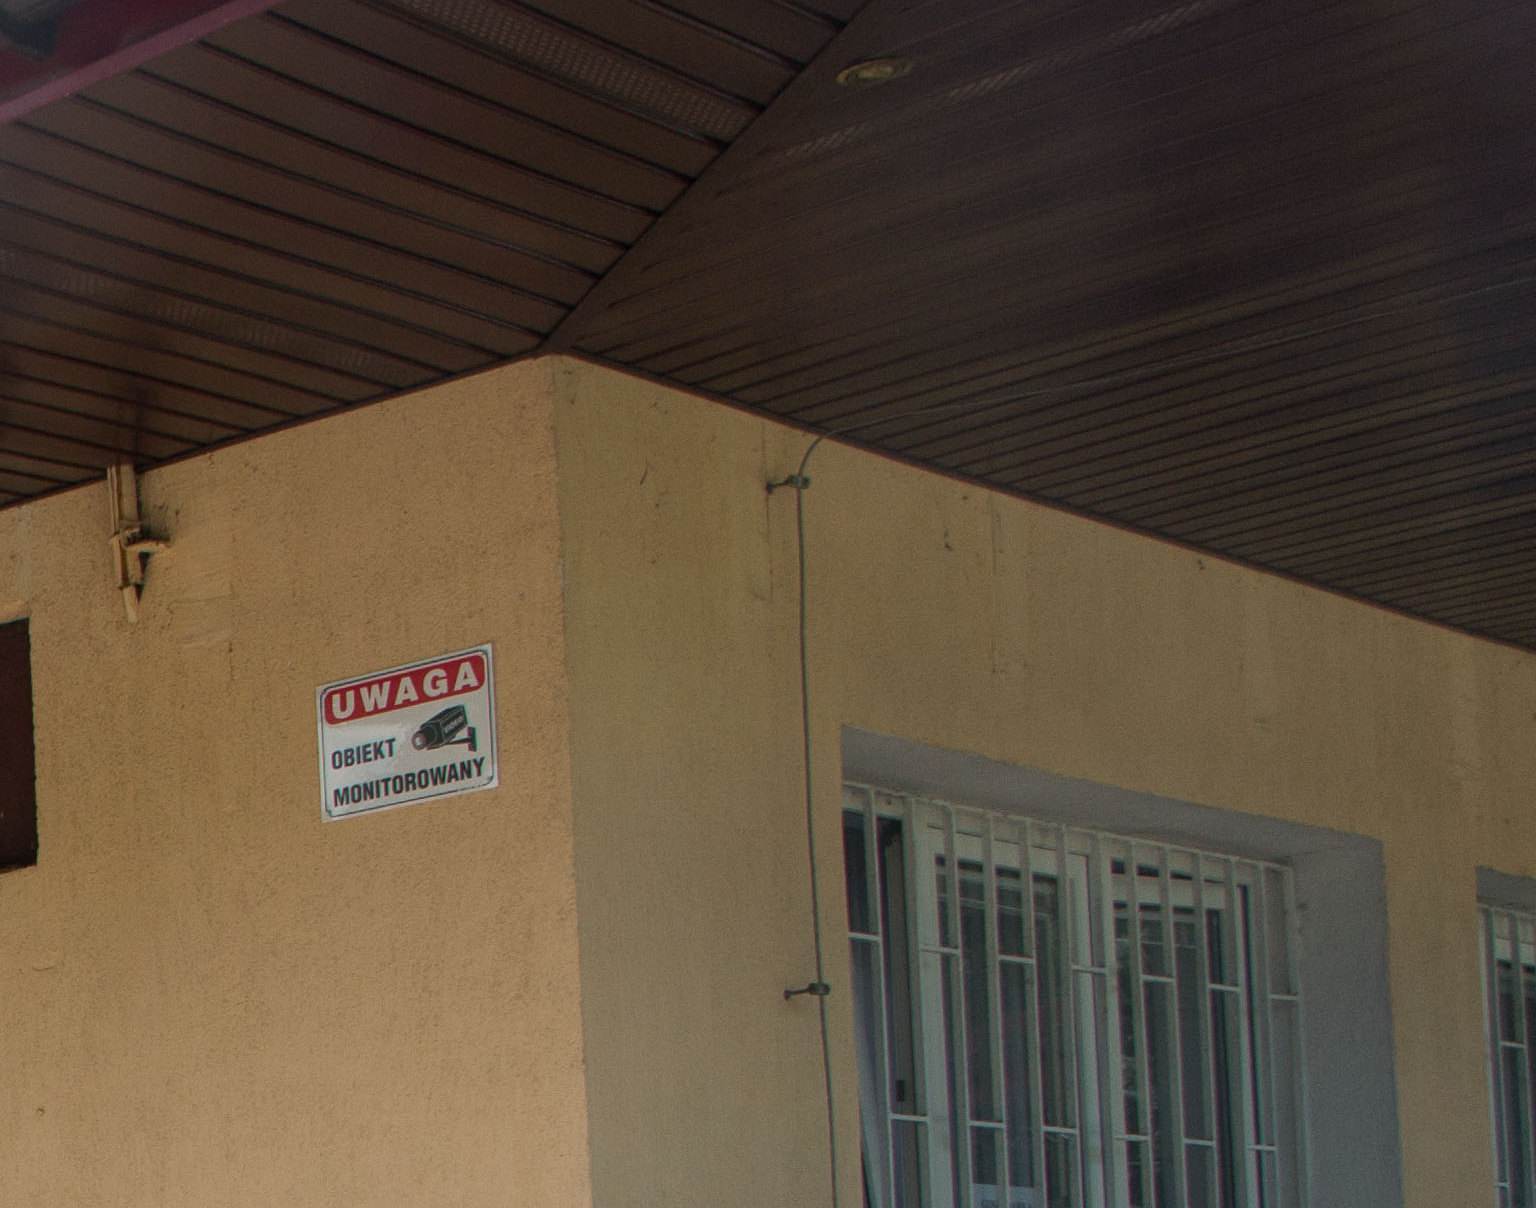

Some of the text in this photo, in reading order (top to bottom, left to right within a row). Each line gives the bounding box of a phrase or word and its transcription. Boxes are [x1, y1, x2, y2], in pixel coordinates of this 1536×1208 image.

[331, 661, 479, 720] UWAGA
[331, 737, 396, 770] OBIEKT
[333, 756, 486, 808] MONITOROWANY
